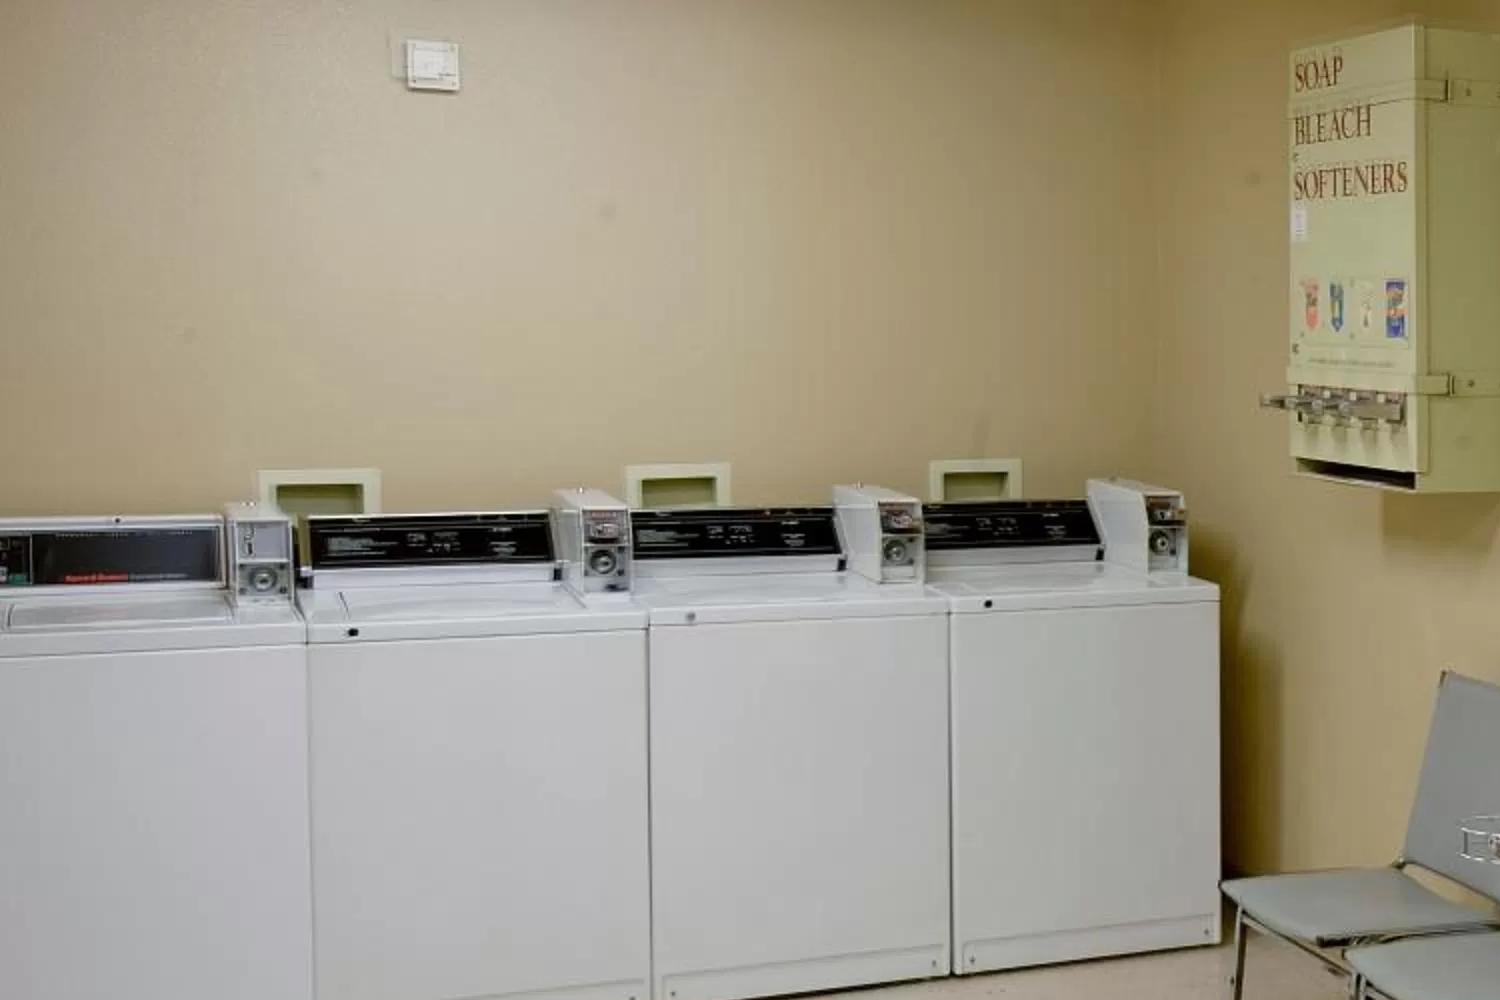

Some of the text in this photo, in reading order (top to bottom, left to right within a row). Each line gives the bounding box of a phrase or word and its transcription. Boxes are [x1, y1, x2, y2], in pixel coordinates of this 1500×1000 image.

[1295, 55, 1343, 93] SOAP
[1295, 104, 1372, 146] BLEACH
[1294, 161, 1408, 201] SOFTENERS
